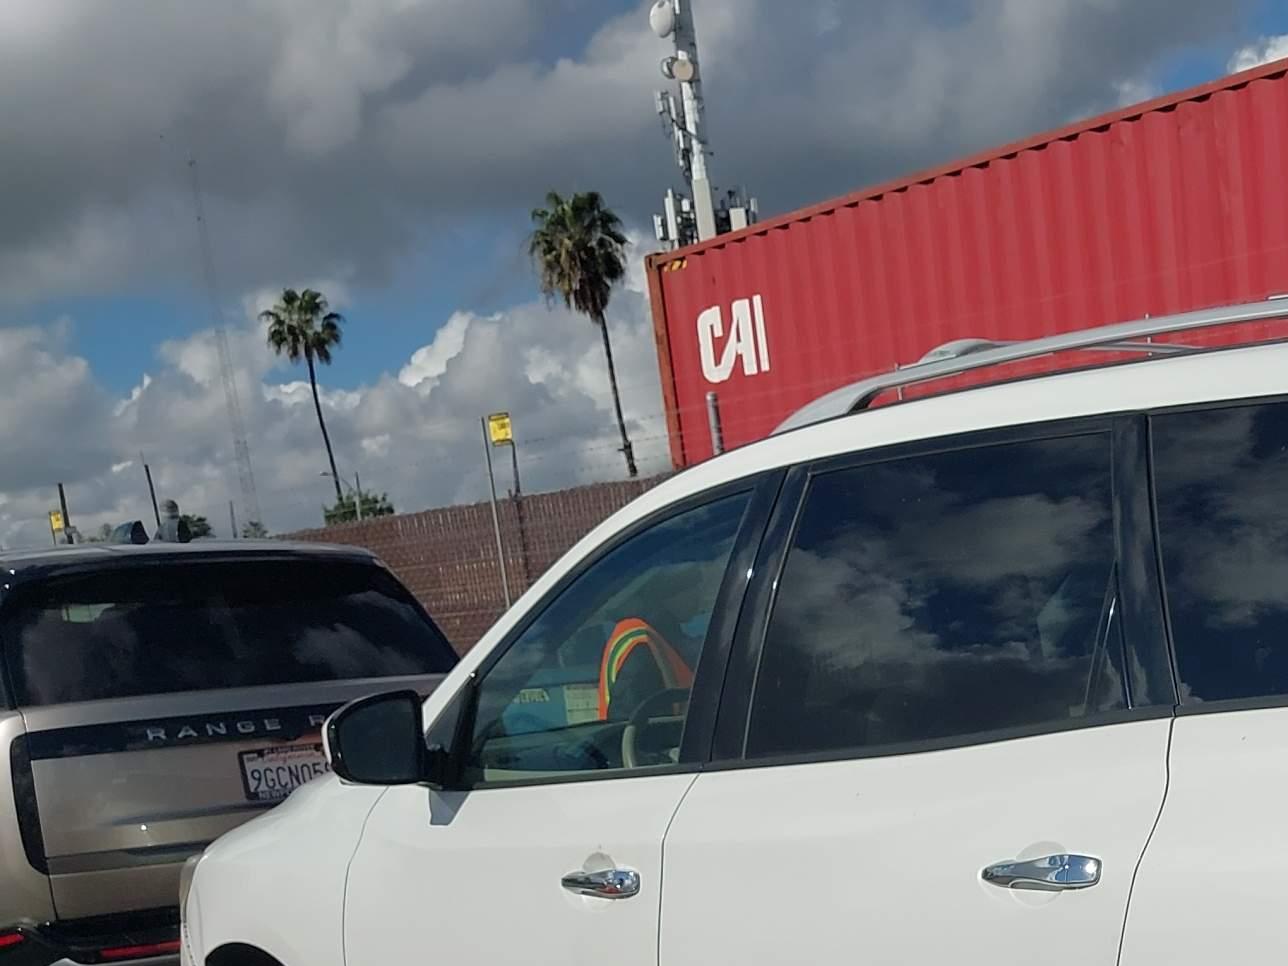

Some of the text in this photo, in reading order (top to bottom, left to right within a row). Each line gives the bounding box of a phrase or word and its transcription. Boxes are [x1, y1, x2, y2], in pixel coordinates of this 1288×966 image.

[697, 294, 770, 384] CAI
[146, 718, 282, 742] RANGE
[250, 763, 332, 792] 9GCN05
